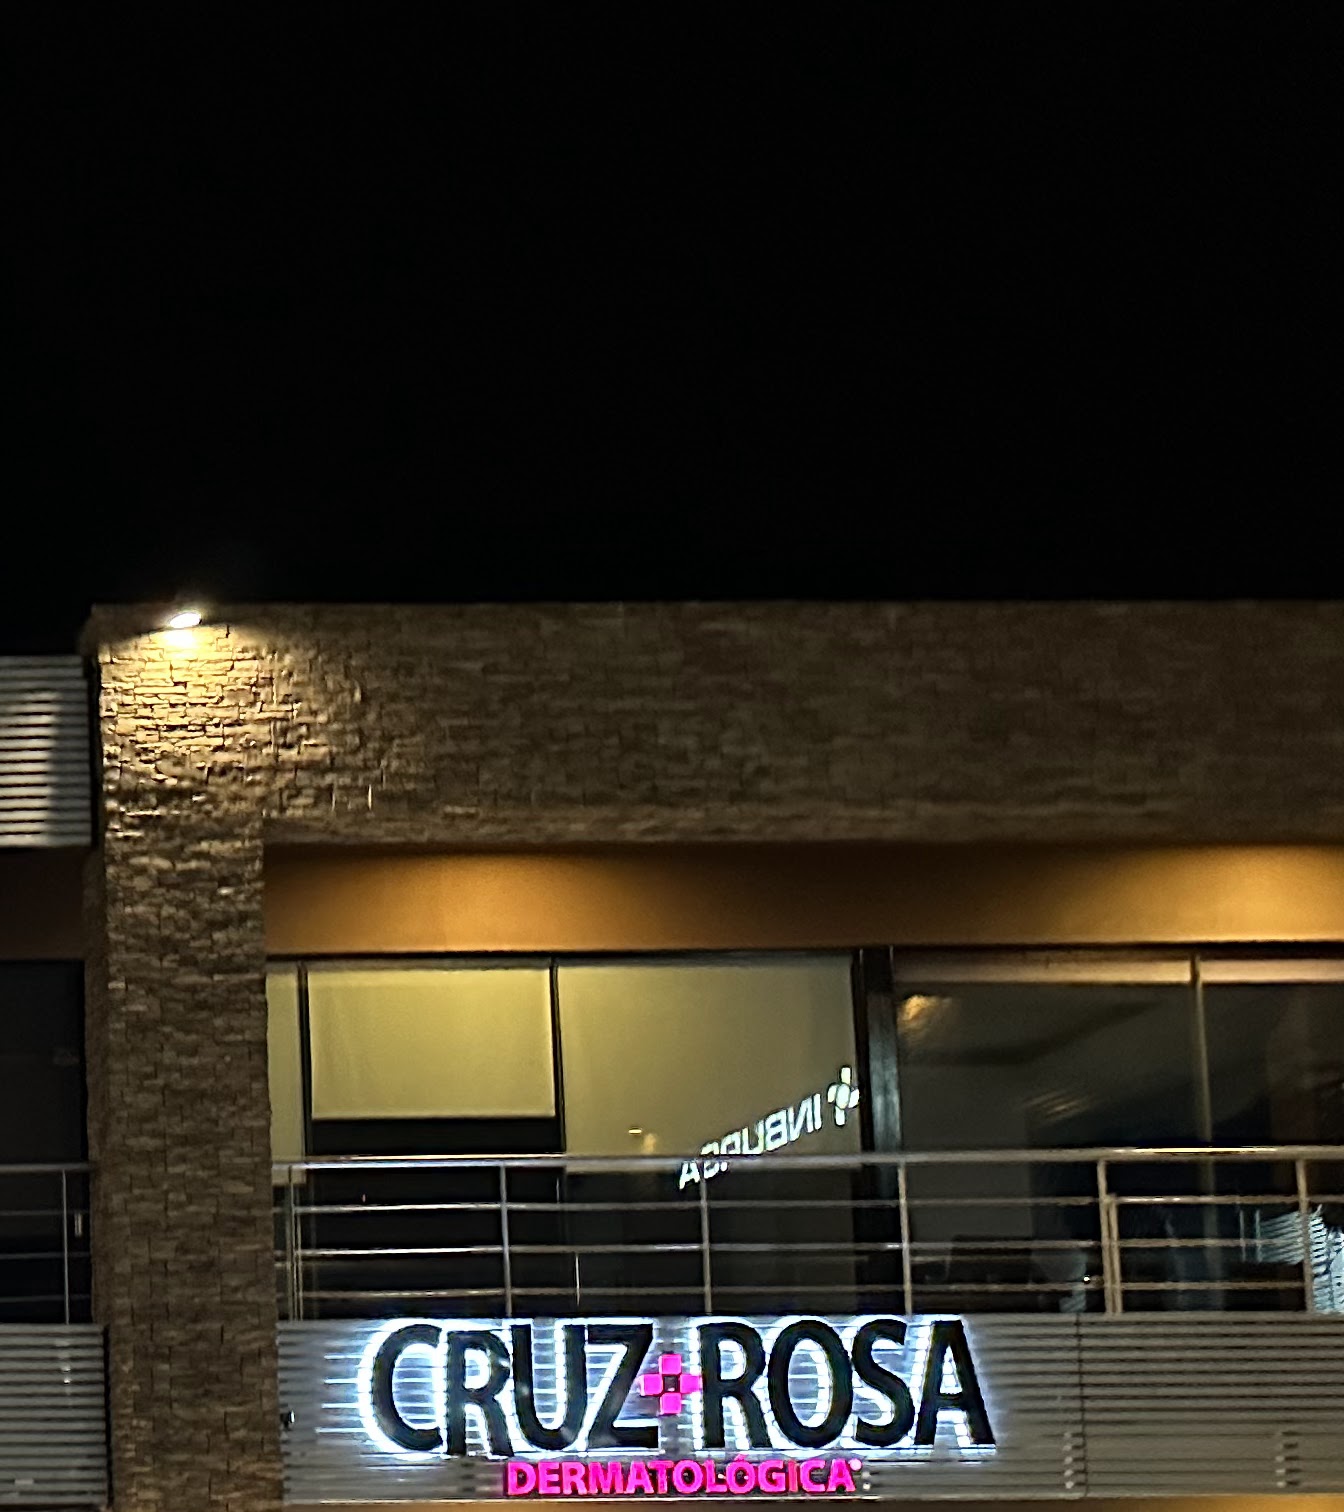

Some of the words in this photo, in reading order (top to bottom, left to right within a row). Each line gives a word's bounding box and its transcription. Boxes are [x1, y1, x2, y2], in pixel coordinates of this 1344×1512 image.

[370, 1322, 660, 1458] CRUZ
[698, 1318, 996, 1452] ROSA
[506, 1454, 858, 1496] DERMATOLÓGICA
